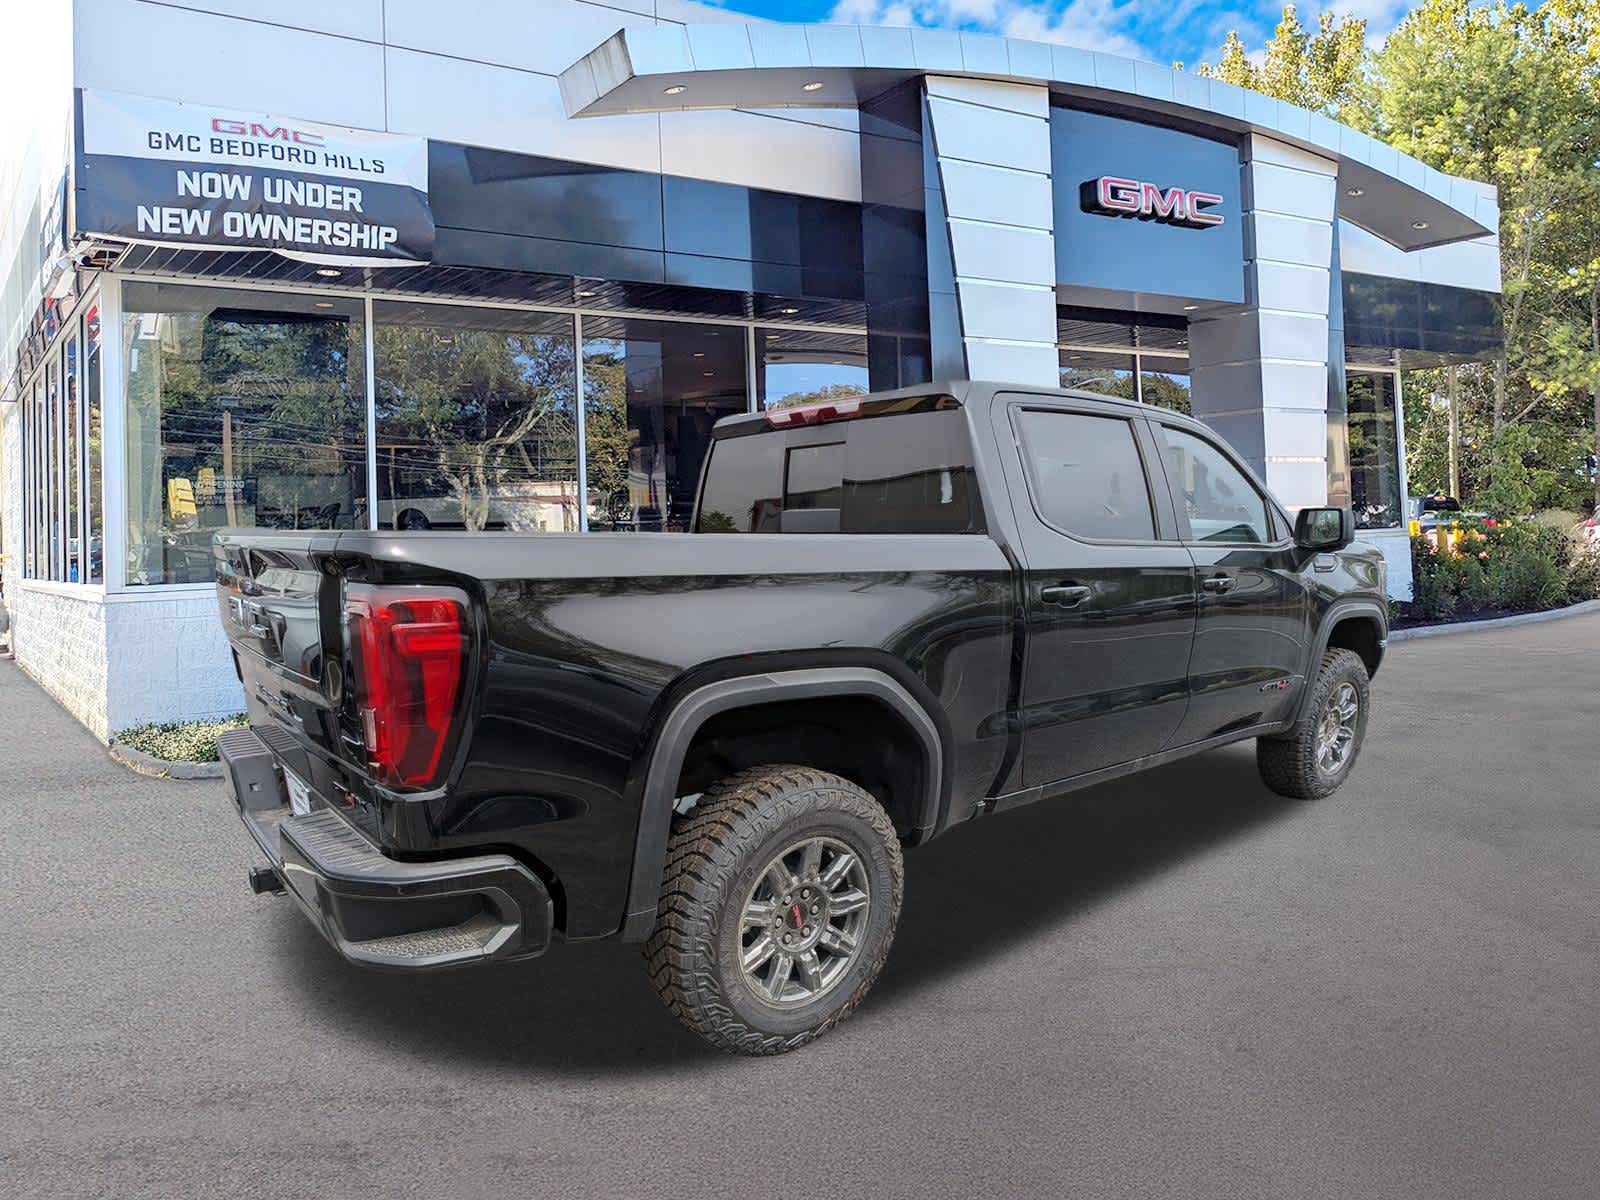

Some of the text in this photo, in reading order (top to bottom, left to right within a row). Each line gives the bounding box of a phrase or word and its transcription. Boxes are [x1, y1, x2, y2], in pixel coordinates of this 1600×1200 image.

[148, 131, 385, 174] GMC BEDFORD HILLS
[211, 117, 326, 147] GMC
[177, 170, 363, 212] NOW UNDER
[1097, 175, 1224, 225] GMC
[137, 206, 398, 250] NEW OWNERSHIP
